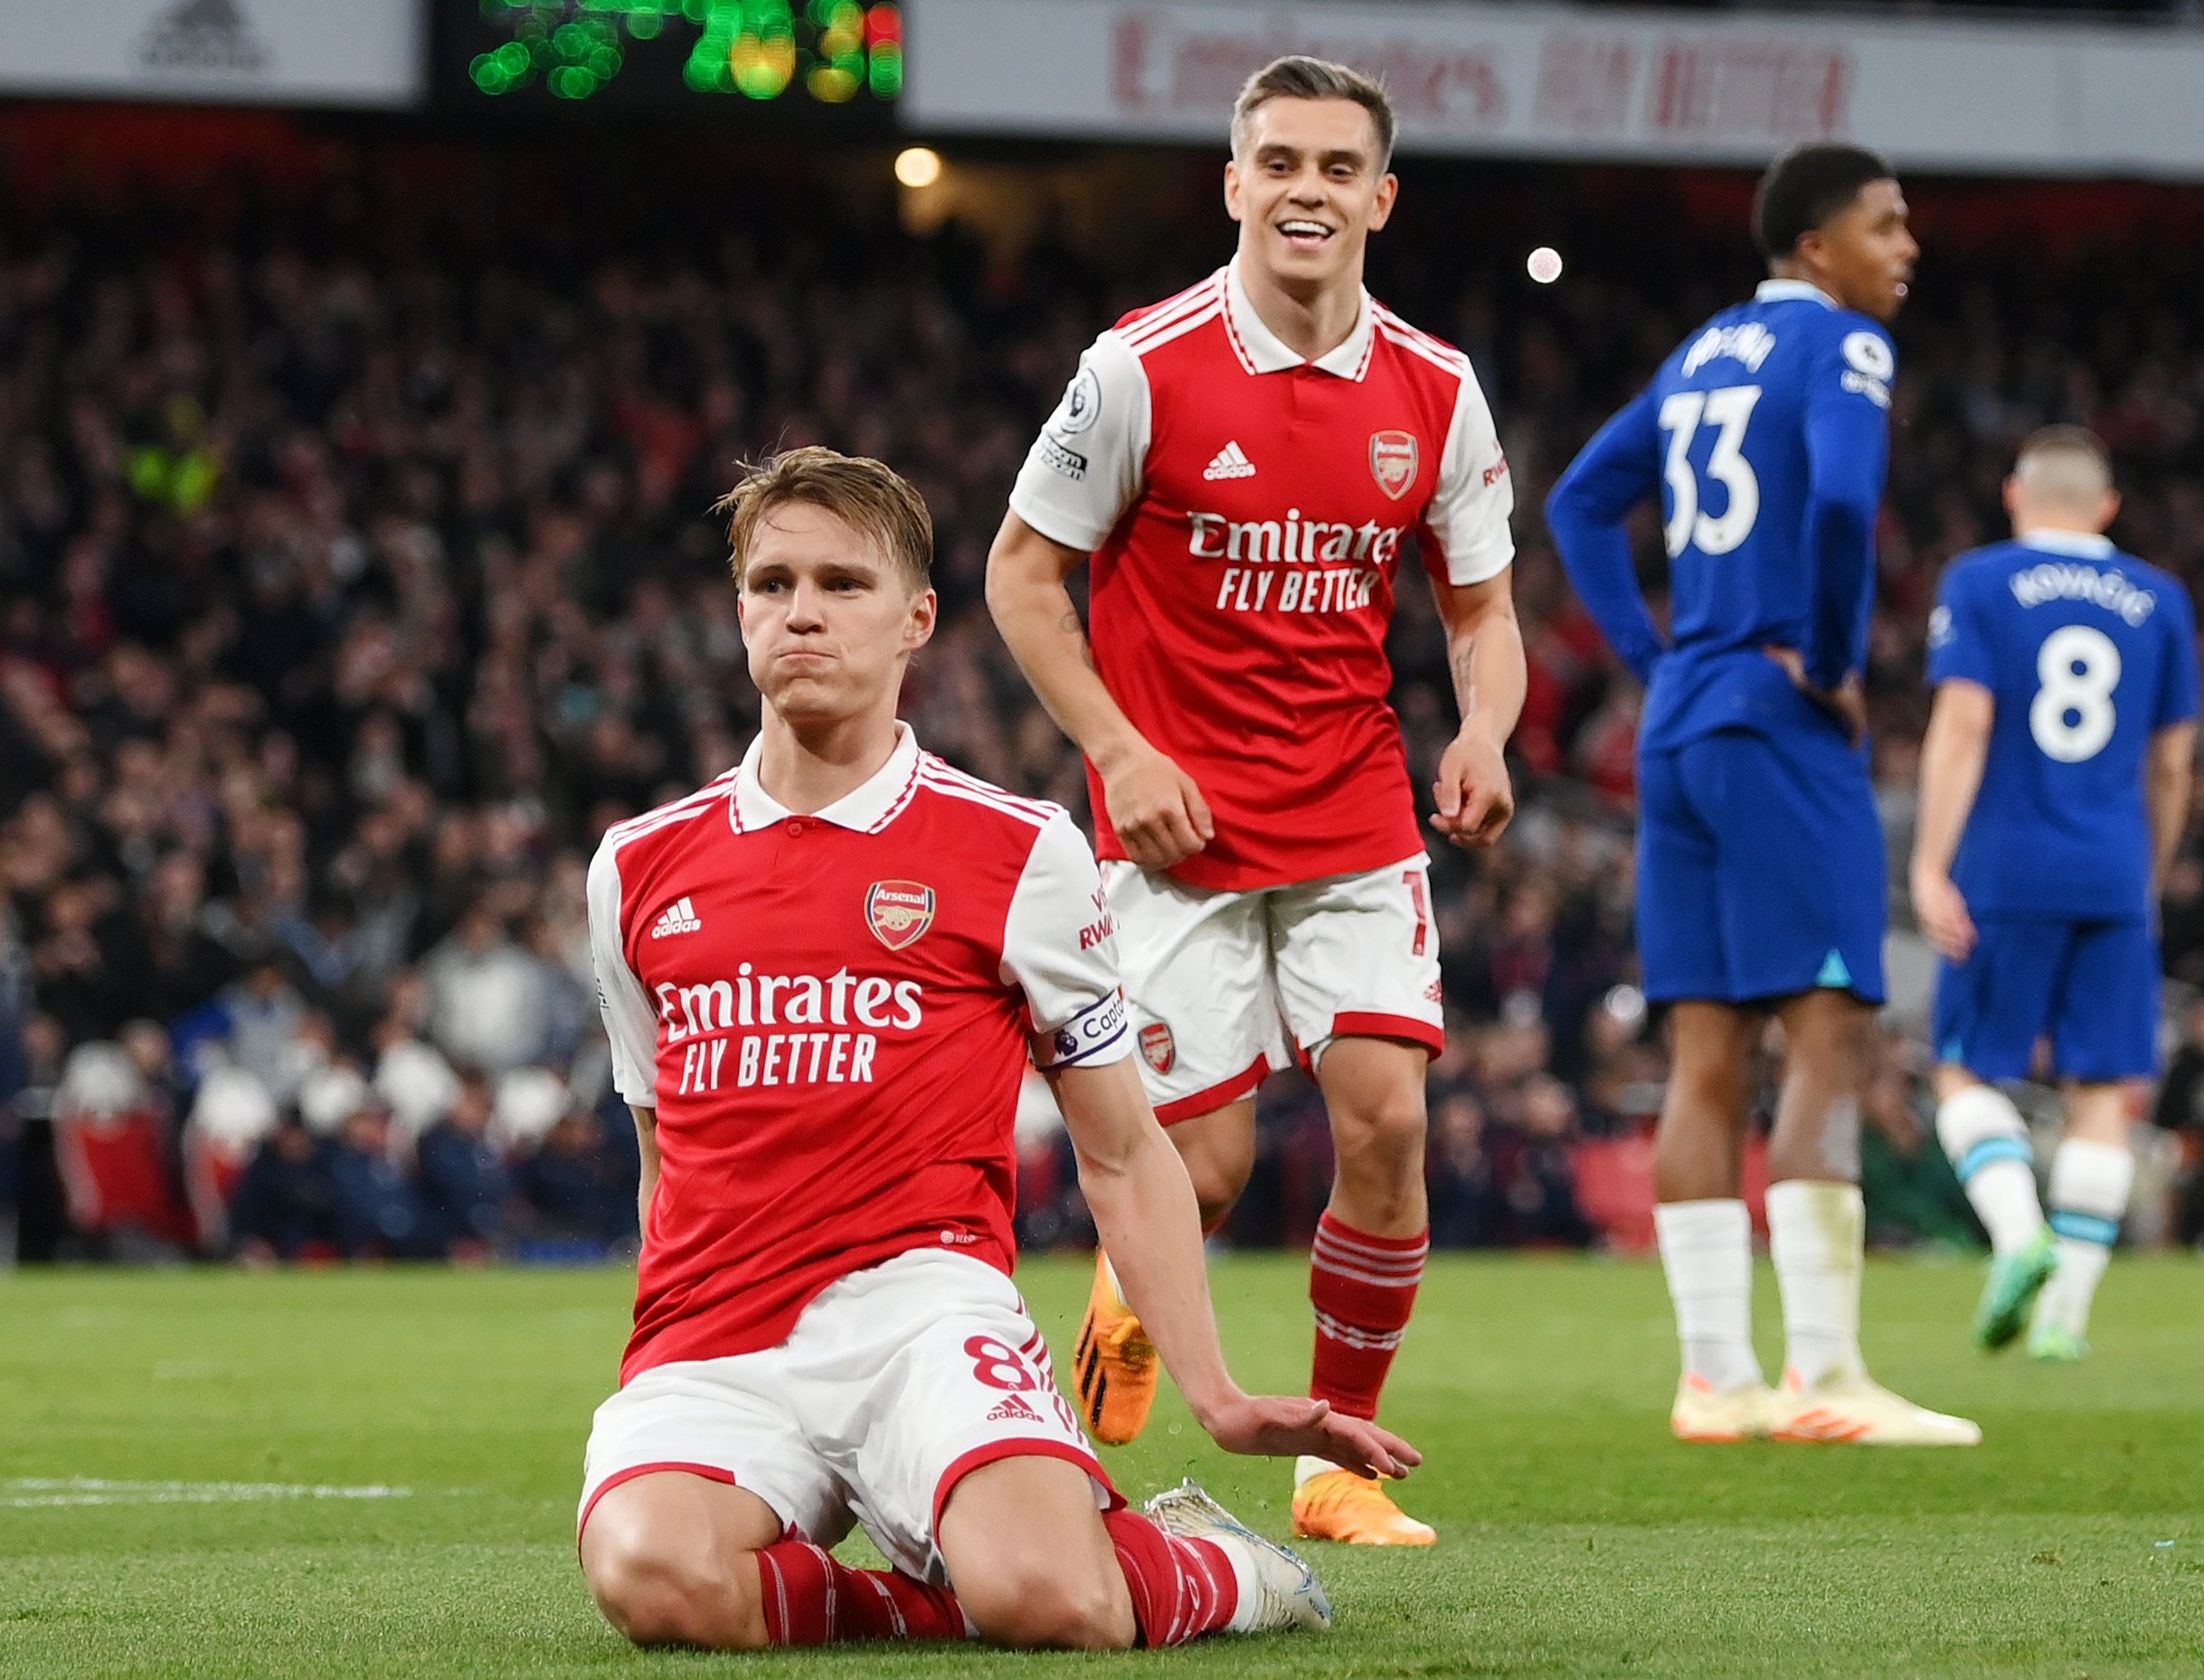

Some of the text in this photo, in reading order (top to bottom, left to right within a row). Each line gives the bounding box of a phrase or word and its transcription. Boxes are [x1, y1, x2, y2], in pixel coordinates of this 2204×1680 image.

[1658, 385, 1763, 559] 33
[1187, 507, 1405, 564] Emirate
[1216, 567, 1381, 613] FLY BETTER
[2029, 625, 2122, 763] 8
[876, 889, 925, 905] Arsenal
[651, 919, 702, 939] adidas
[655, 962, 922, 1043] Emirates
[678, 1033, 877, 1095] FLY BETTER
[963, 1335, 1037, 1391] 8
[986, 1407, 1045, 1423] adidas
